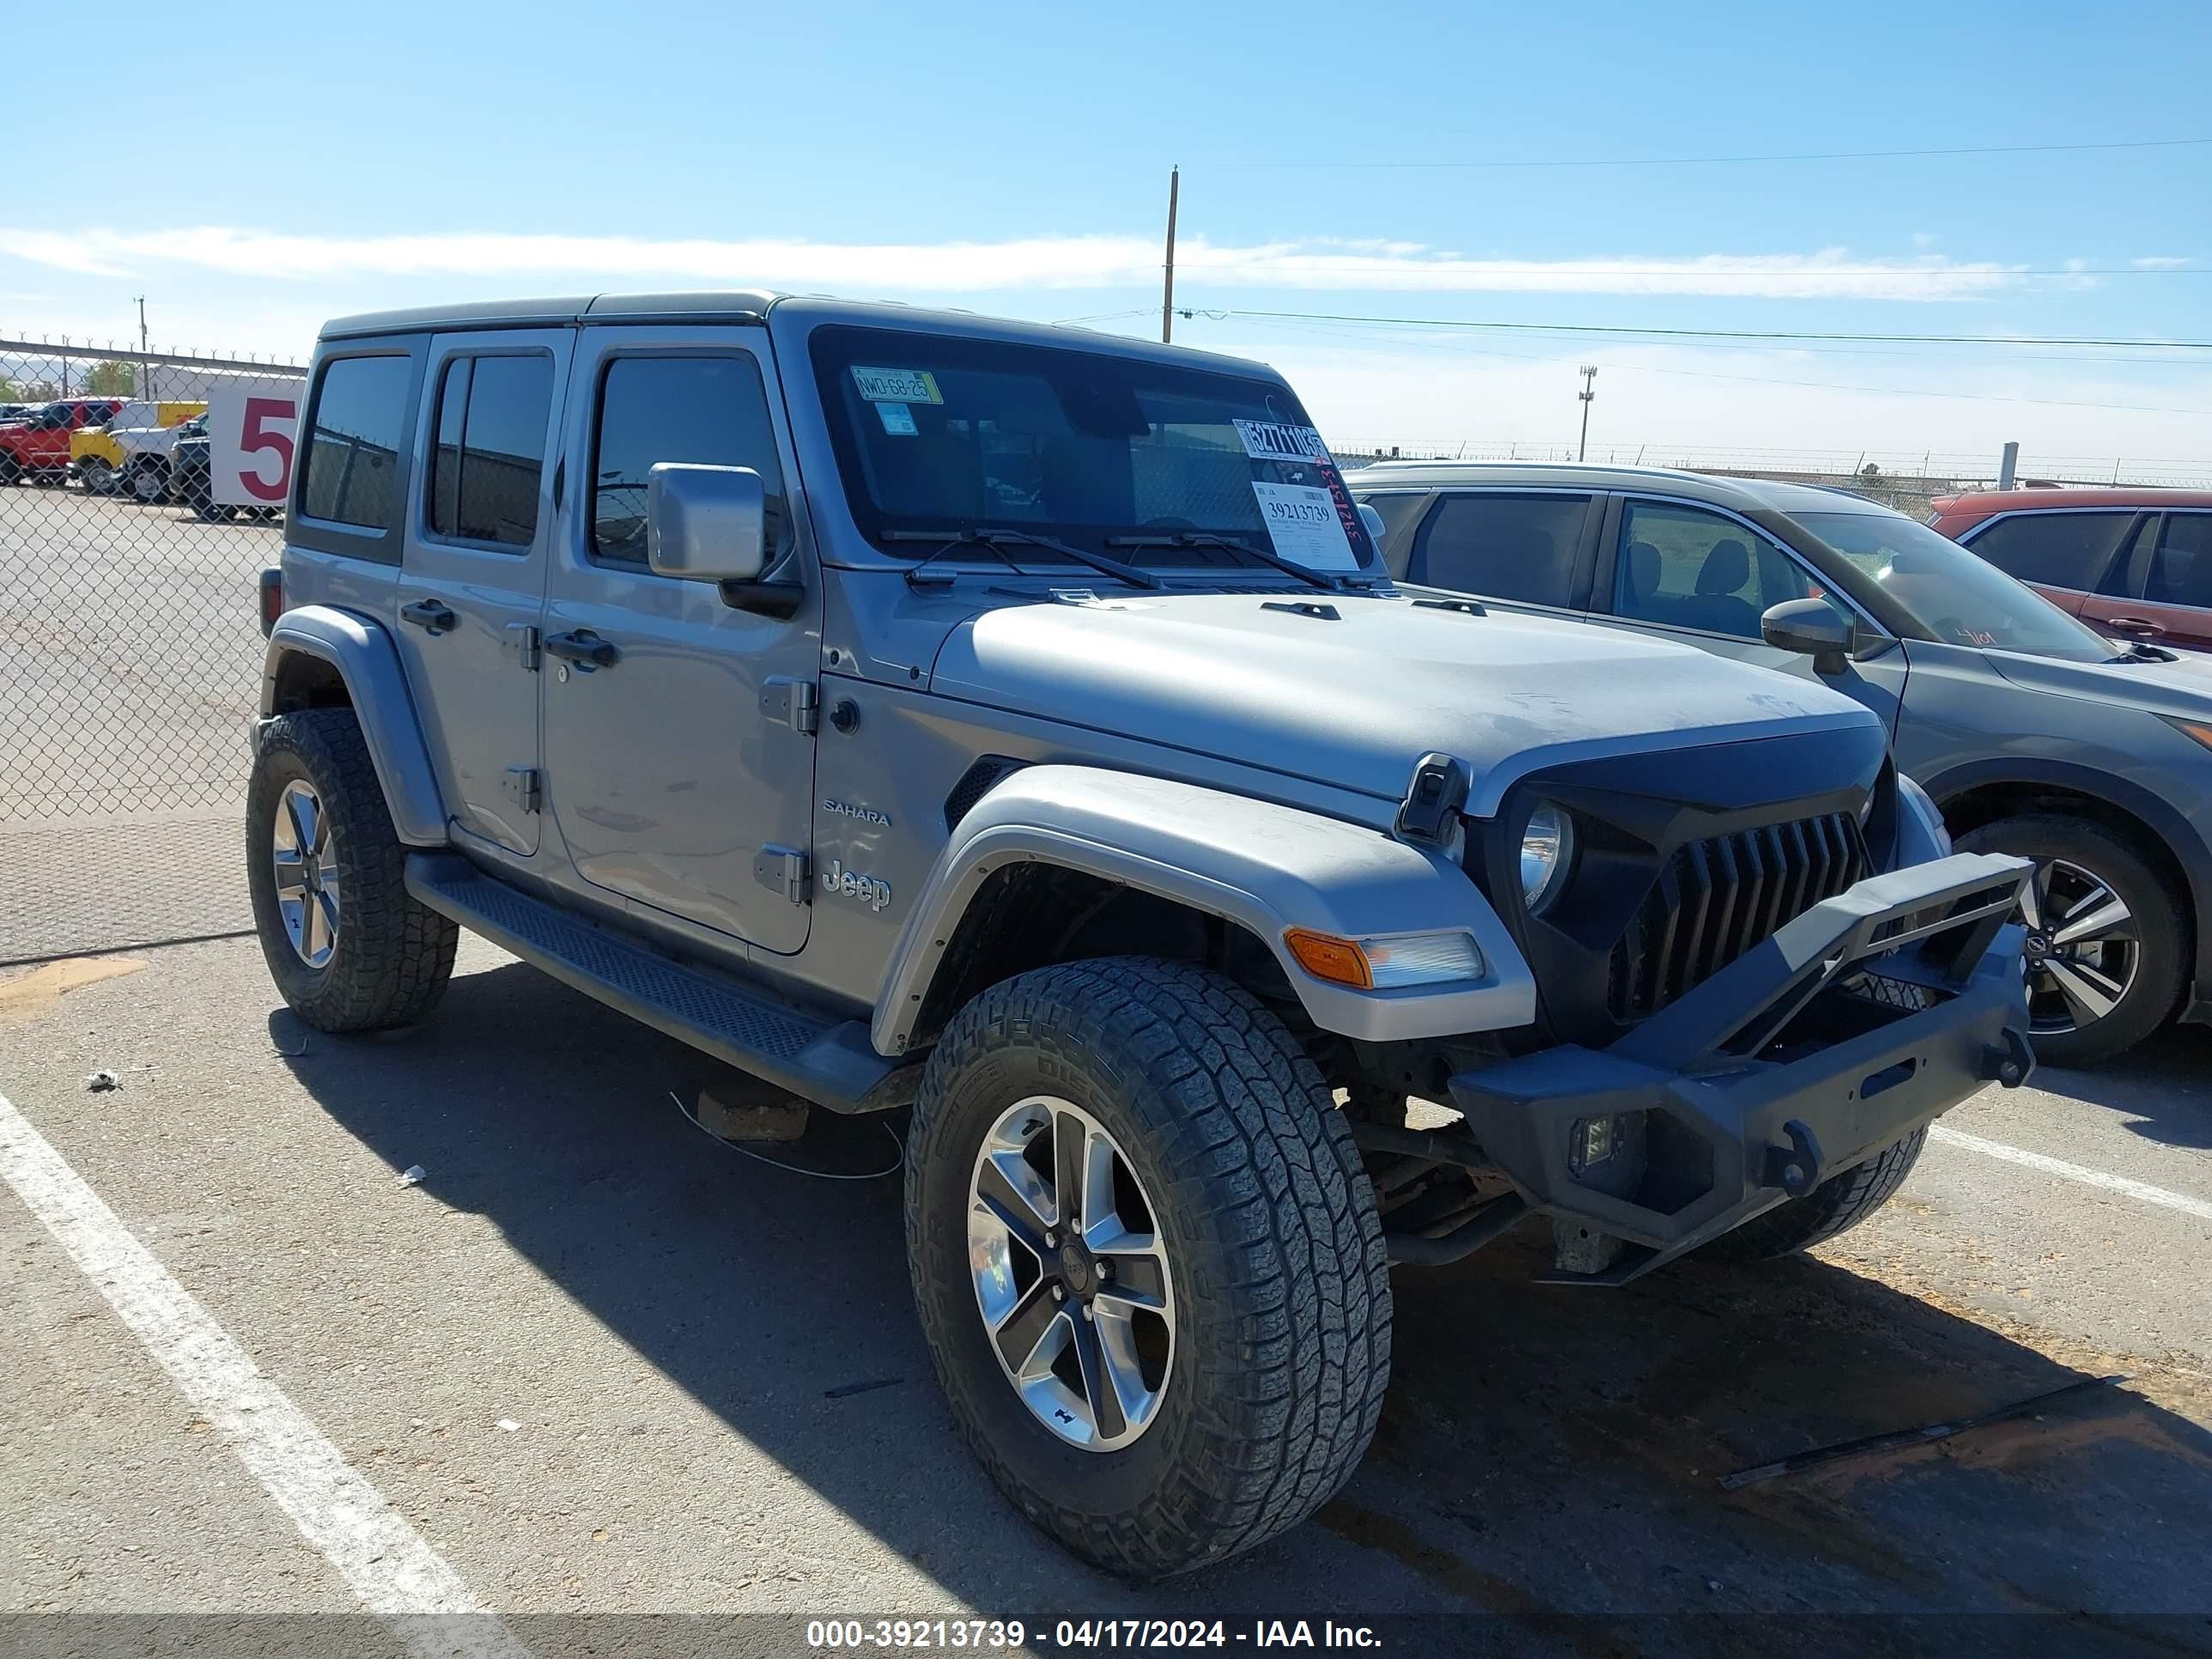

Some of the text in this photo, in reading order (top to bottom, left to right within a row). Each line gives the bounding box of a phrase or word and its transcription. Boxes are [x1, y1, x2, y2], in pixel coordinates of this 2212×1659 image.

[239, 398, 295, 501] 5
[1246, 422, 1319, 457] 52771103
[1268, 502, 1329, 522] 39213739
[823, 799, 890, 826] SAHARA
[823, 860, 890, 913] Jeep
